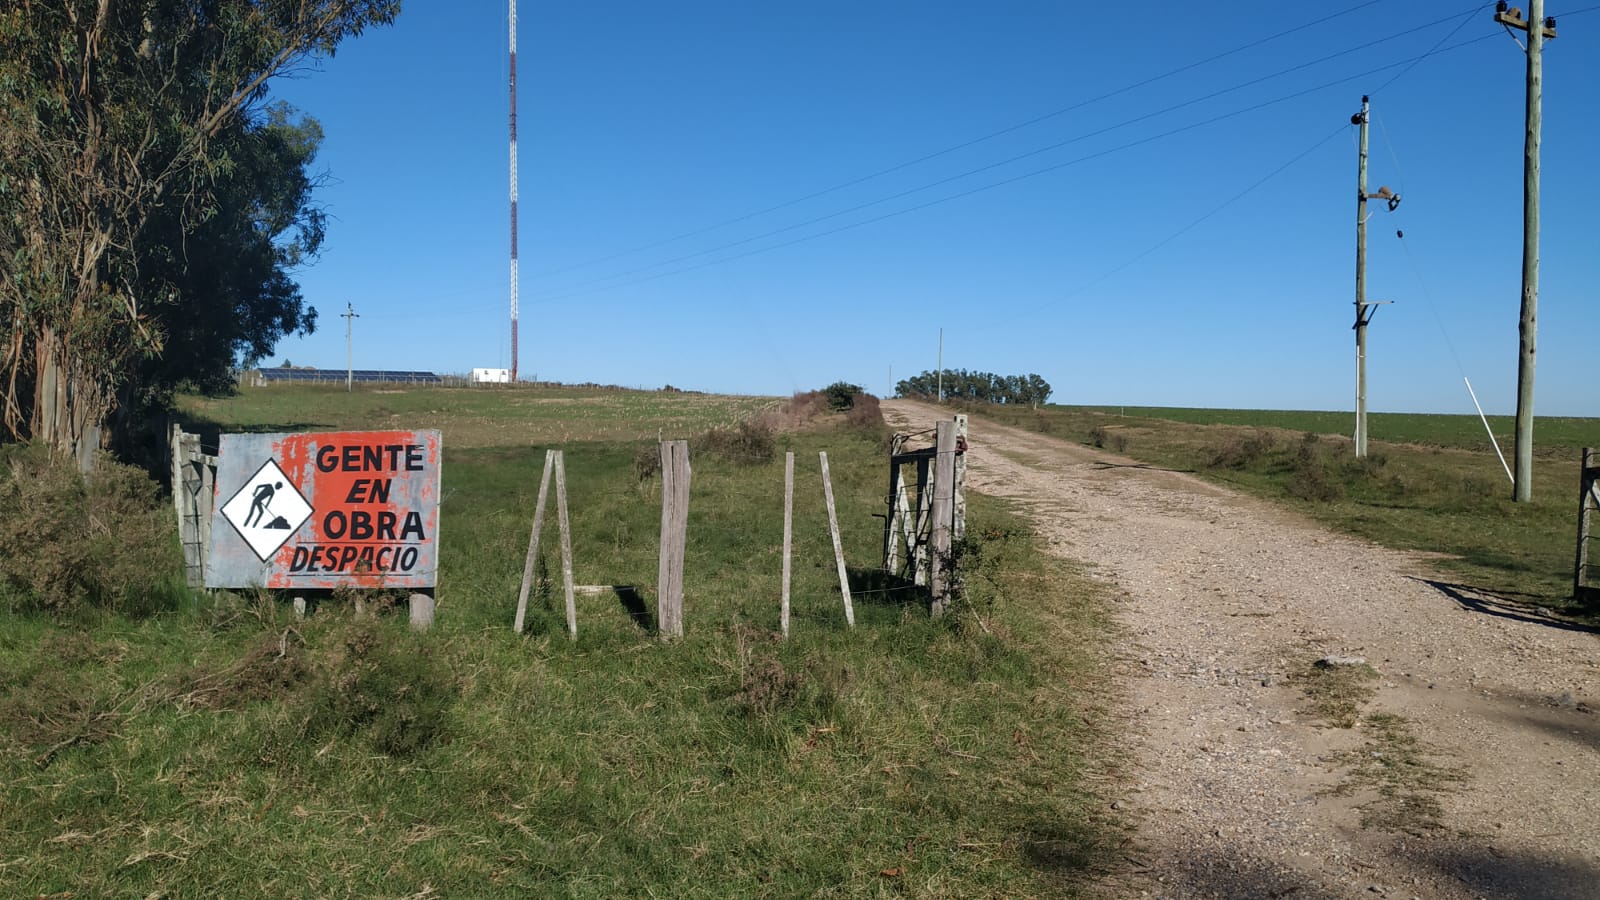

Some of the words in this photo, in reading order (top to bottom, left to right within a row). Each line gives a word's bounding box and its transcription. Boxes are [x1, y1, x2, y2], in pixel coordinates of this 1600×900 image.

[316, 444, 424, 473] GENTE
[345, 479, 391, 503] EN
[323, 510, 425, 540] OBRA
[289, 546, 418, 572] DESPACIO
